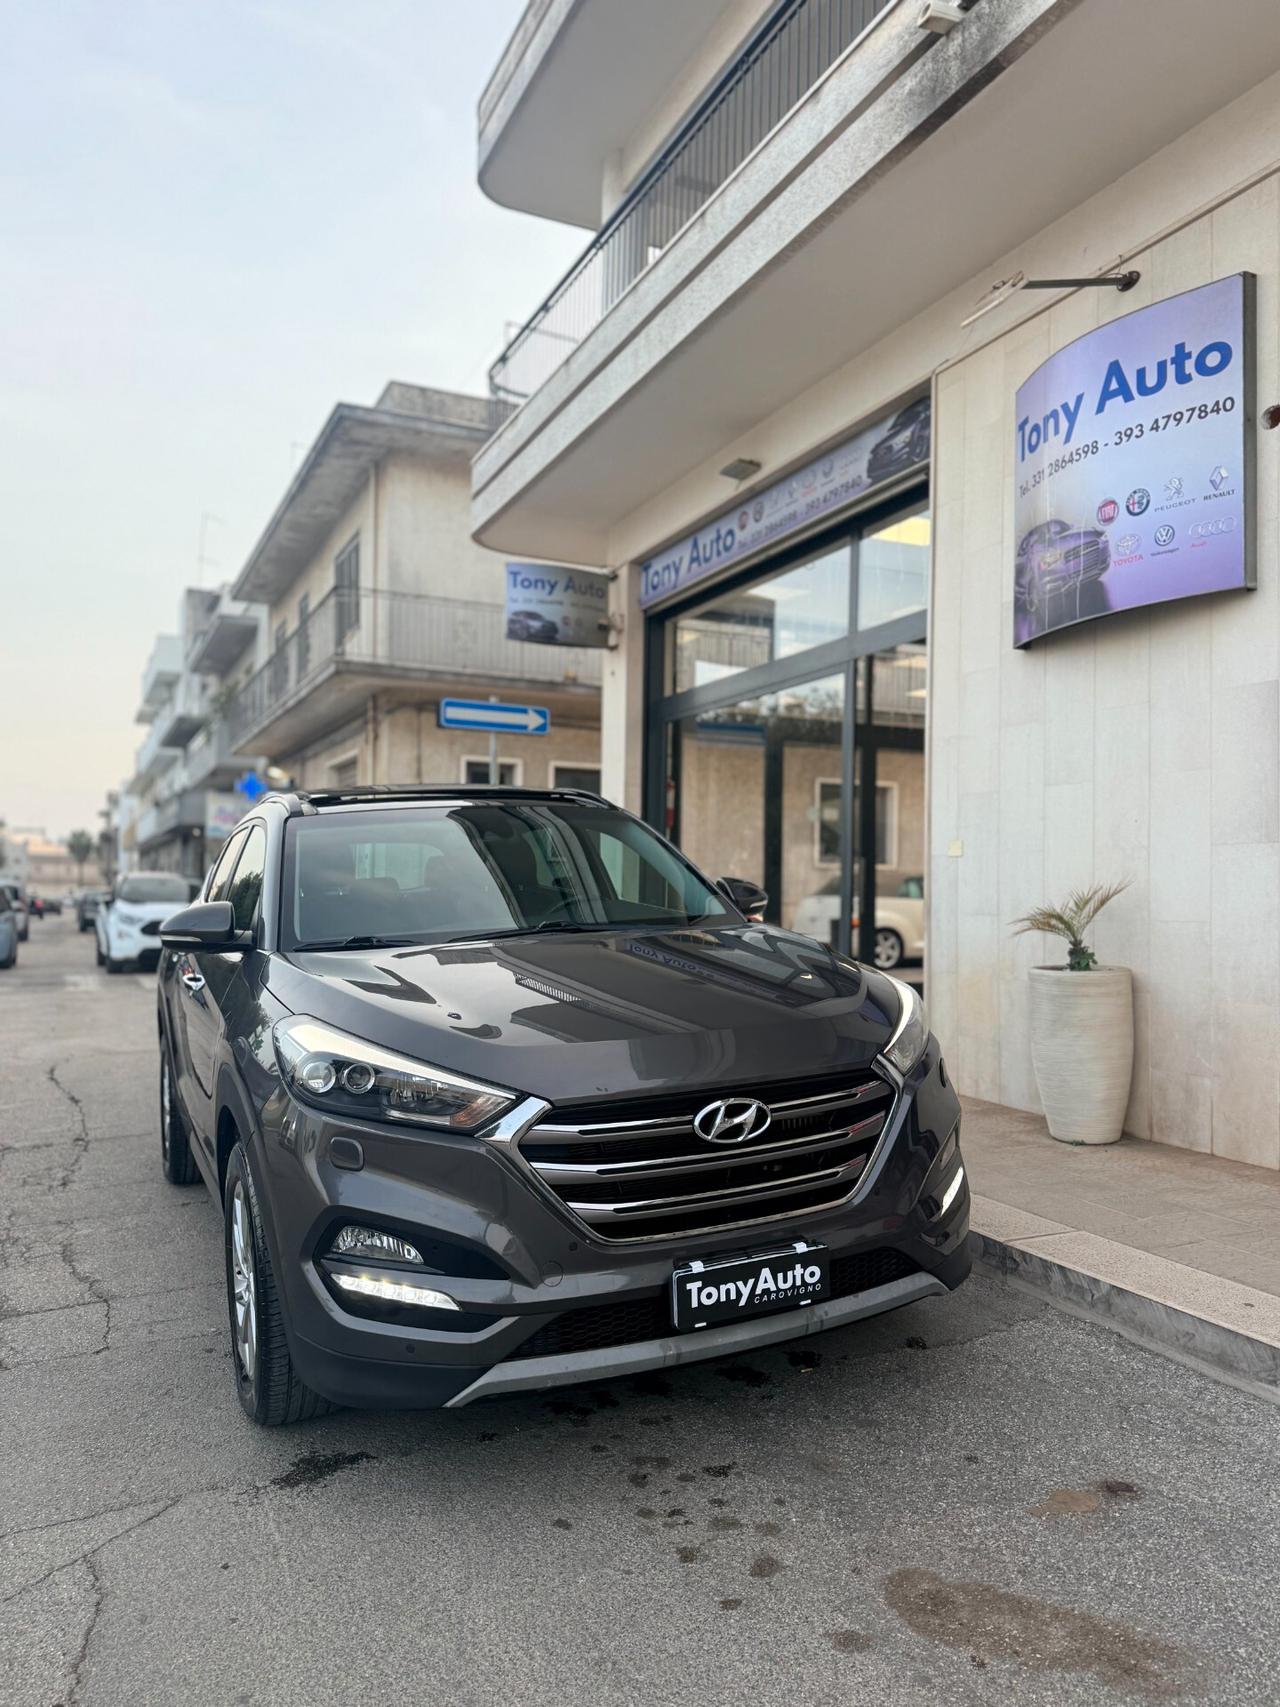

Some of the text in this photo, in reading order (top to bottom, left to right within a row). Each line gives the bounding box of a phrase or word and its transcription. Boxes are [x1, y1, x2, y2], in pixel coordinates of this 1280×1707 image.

[1018, 341, 1233, 463] Tony Auto
[1032, 469, 1045, 489] 331
[1048, 440, 1099, 478] 2864598
[1114, 423, 1144, 447] 393
[1149, 396, 1235, 433] 4797840
[1154, 498, 1197, 513] PEUGEOT
[1203, 489, 1235, 502] RENAULT
[641, 560, 684, 597] Tony
[687, 524, 737, 575] Auto
[1112, 554, 1144, 567] TOYOTA
[510, 571, 606, 599] Tony Auto
[754, 1283, 822, 1303] CAROVIGNO
